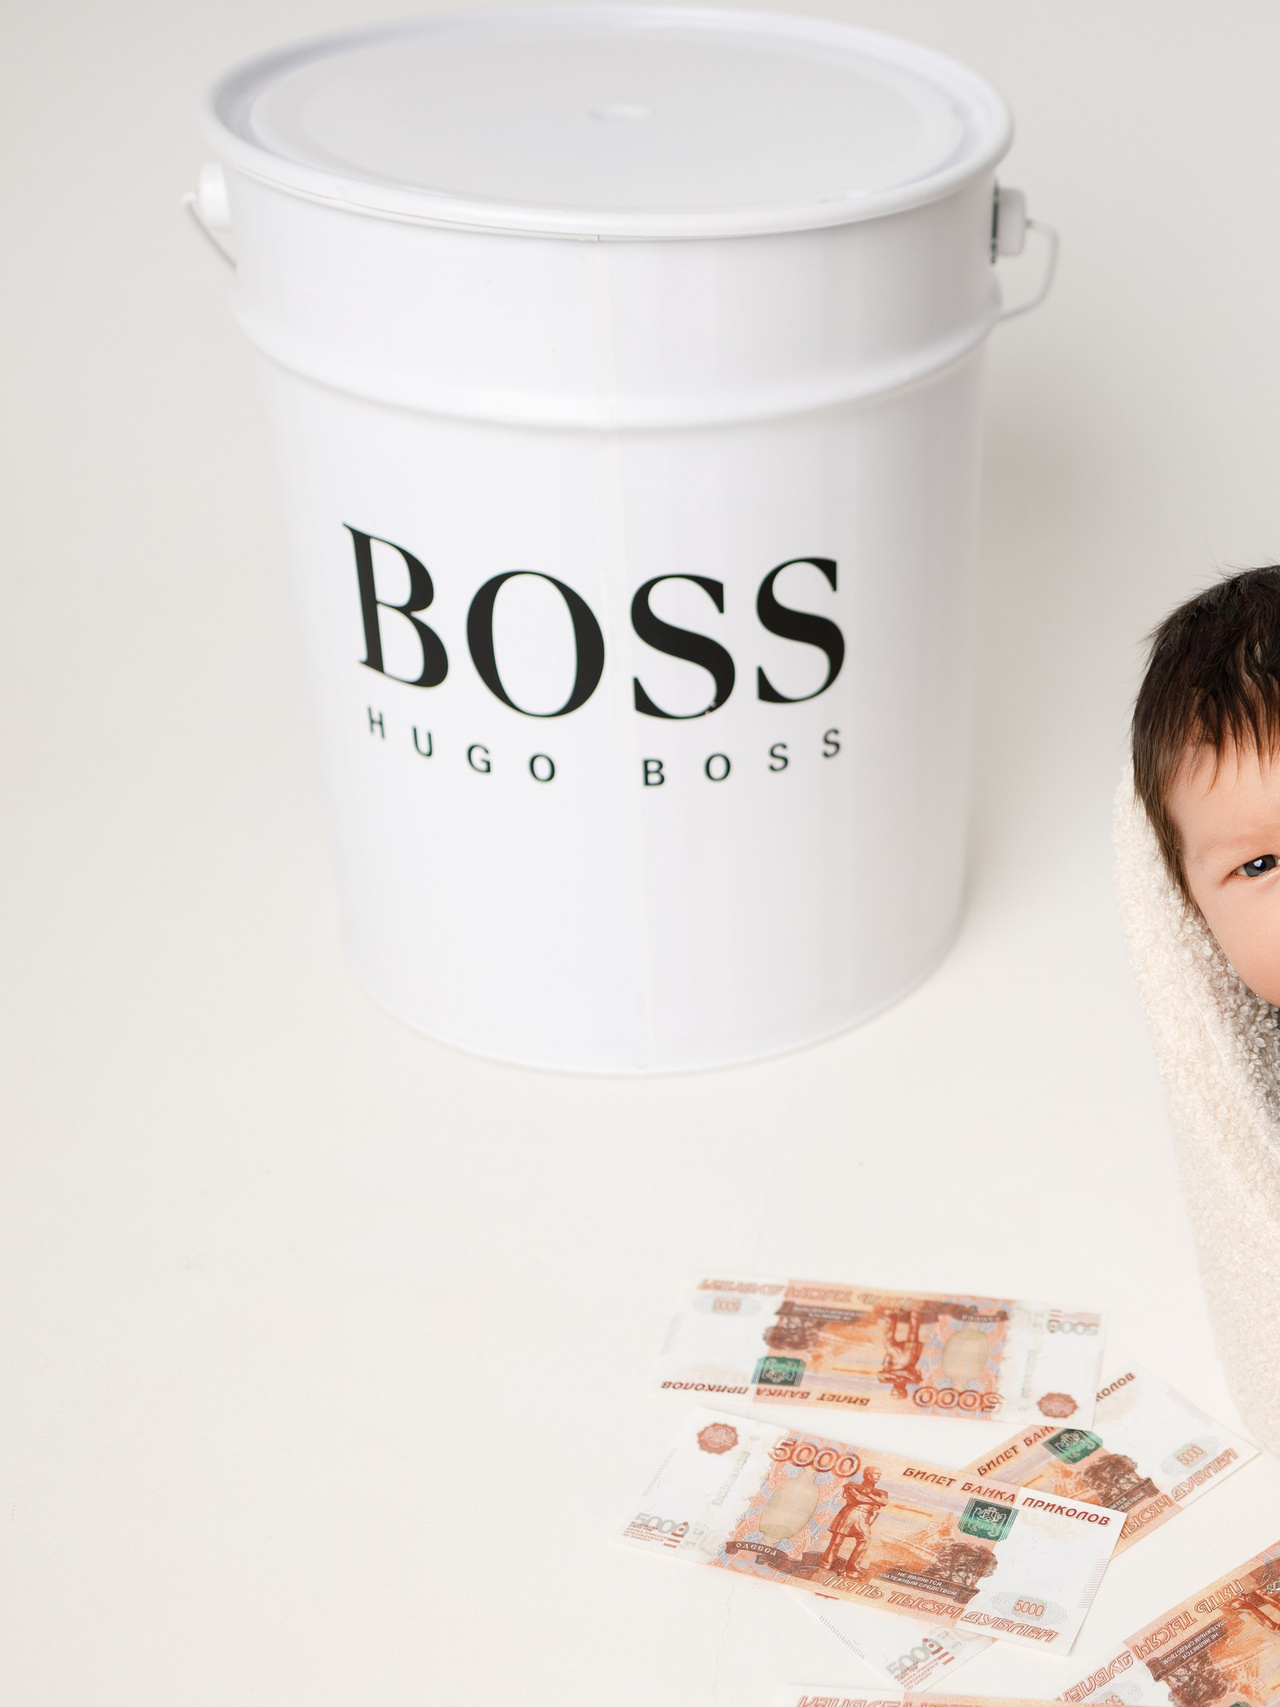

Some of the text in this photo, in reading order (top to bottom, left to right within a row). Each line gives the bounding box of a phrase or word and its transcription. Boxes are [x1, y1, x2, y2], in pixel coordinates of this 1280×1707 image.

[342, 522, 845, 720] BOSS
[367, 705, 842, 787] HUGO BOSS
[660, 1381, 870, 1406] БИЛЕТ БАНКА ПРИКОЛОВ
[912, 1386, 1005, 1412] 5000
[977, 1372, 1136, 1477] БИЛЕТ БАН КОЛОВ
[768, 1437, 862, 1479] 5000
[902, 1467, 1111, 1527] БИЛЕТ БАНКА ПРИКОЛОВ
[633, 1512, 691, 1538] 5000
[822, 1575, 1060, 1644] ПЯТЬ ТЫСЯЧ ДУБЛЕЙ
[1013, 1599, 1046, 1617] 5000
[1194, 1578, 1245, 1615] ПЯТЬ
[1132, 1609, 1198, 1661] ТЫСЯЧ
